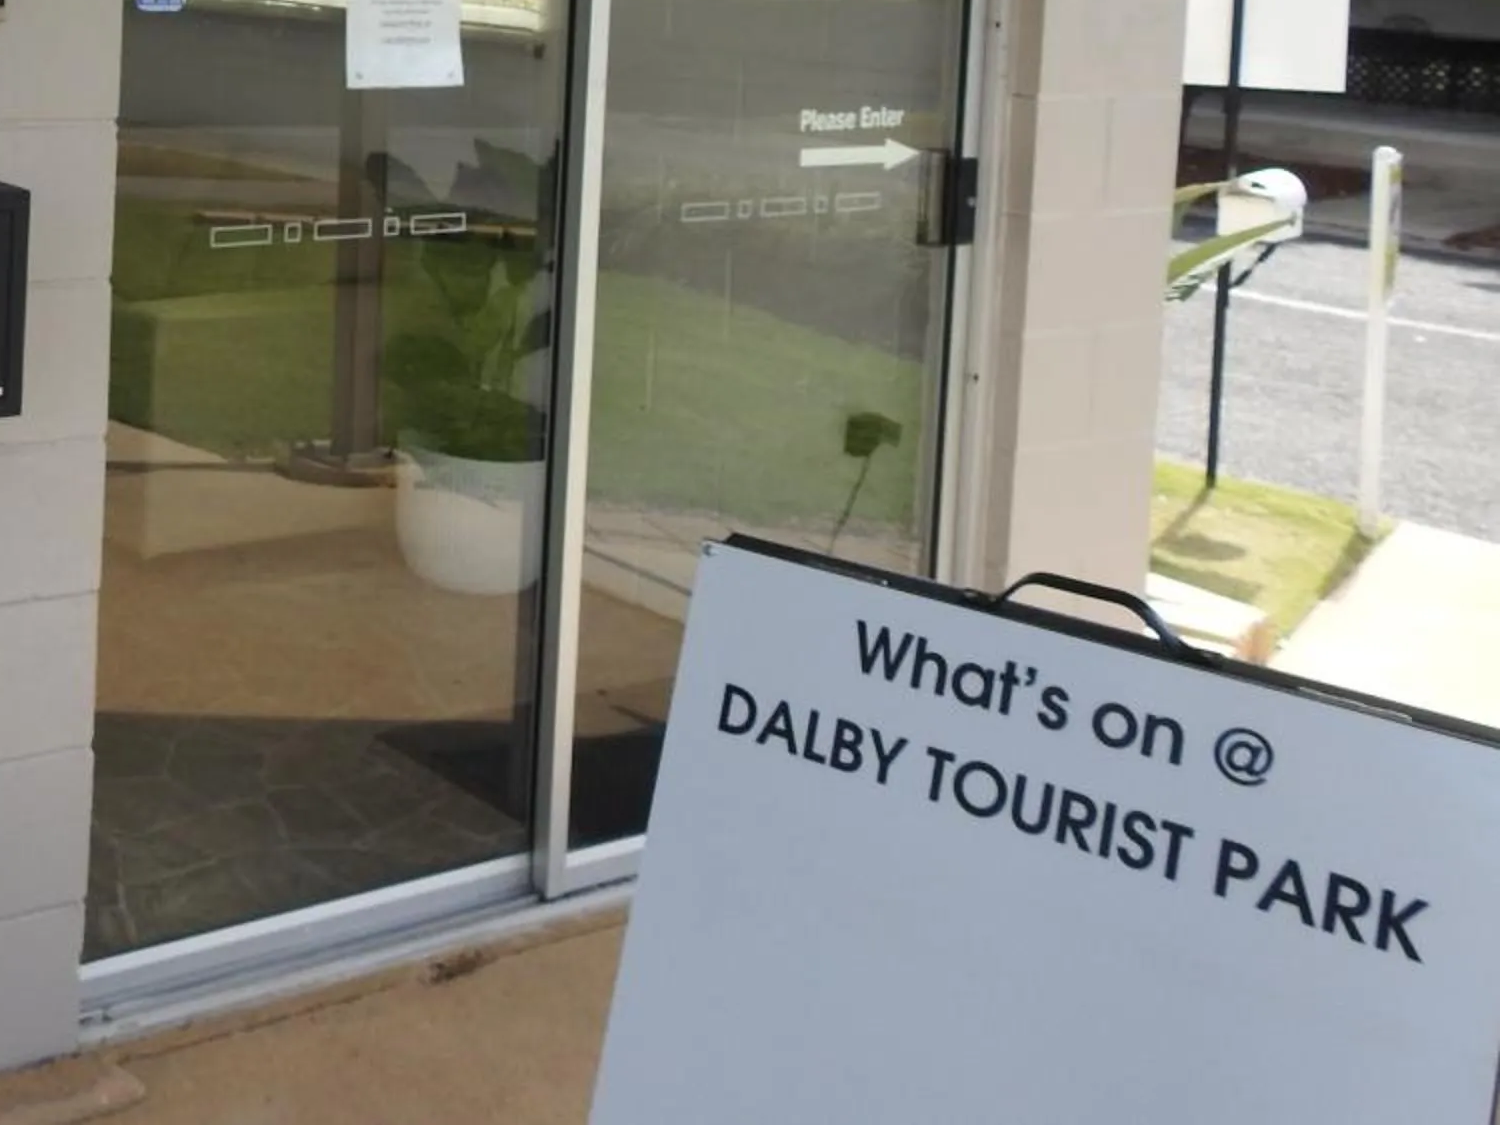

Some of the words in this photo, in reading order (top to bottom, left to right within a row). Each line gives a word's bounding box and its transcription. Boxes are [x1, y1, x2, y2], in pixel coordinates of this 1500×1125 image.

[800, 108, 857, 132] Please
[860, 105, 904, 129] Enter
[1092, 701, 1184, 766] on
[1213, 727, 1276, 786] @
[717, 683, 909, 786] DALBY
[926, 746, 1195, 881] TOURIST
[1212, 838, 1430, 964] PARK
